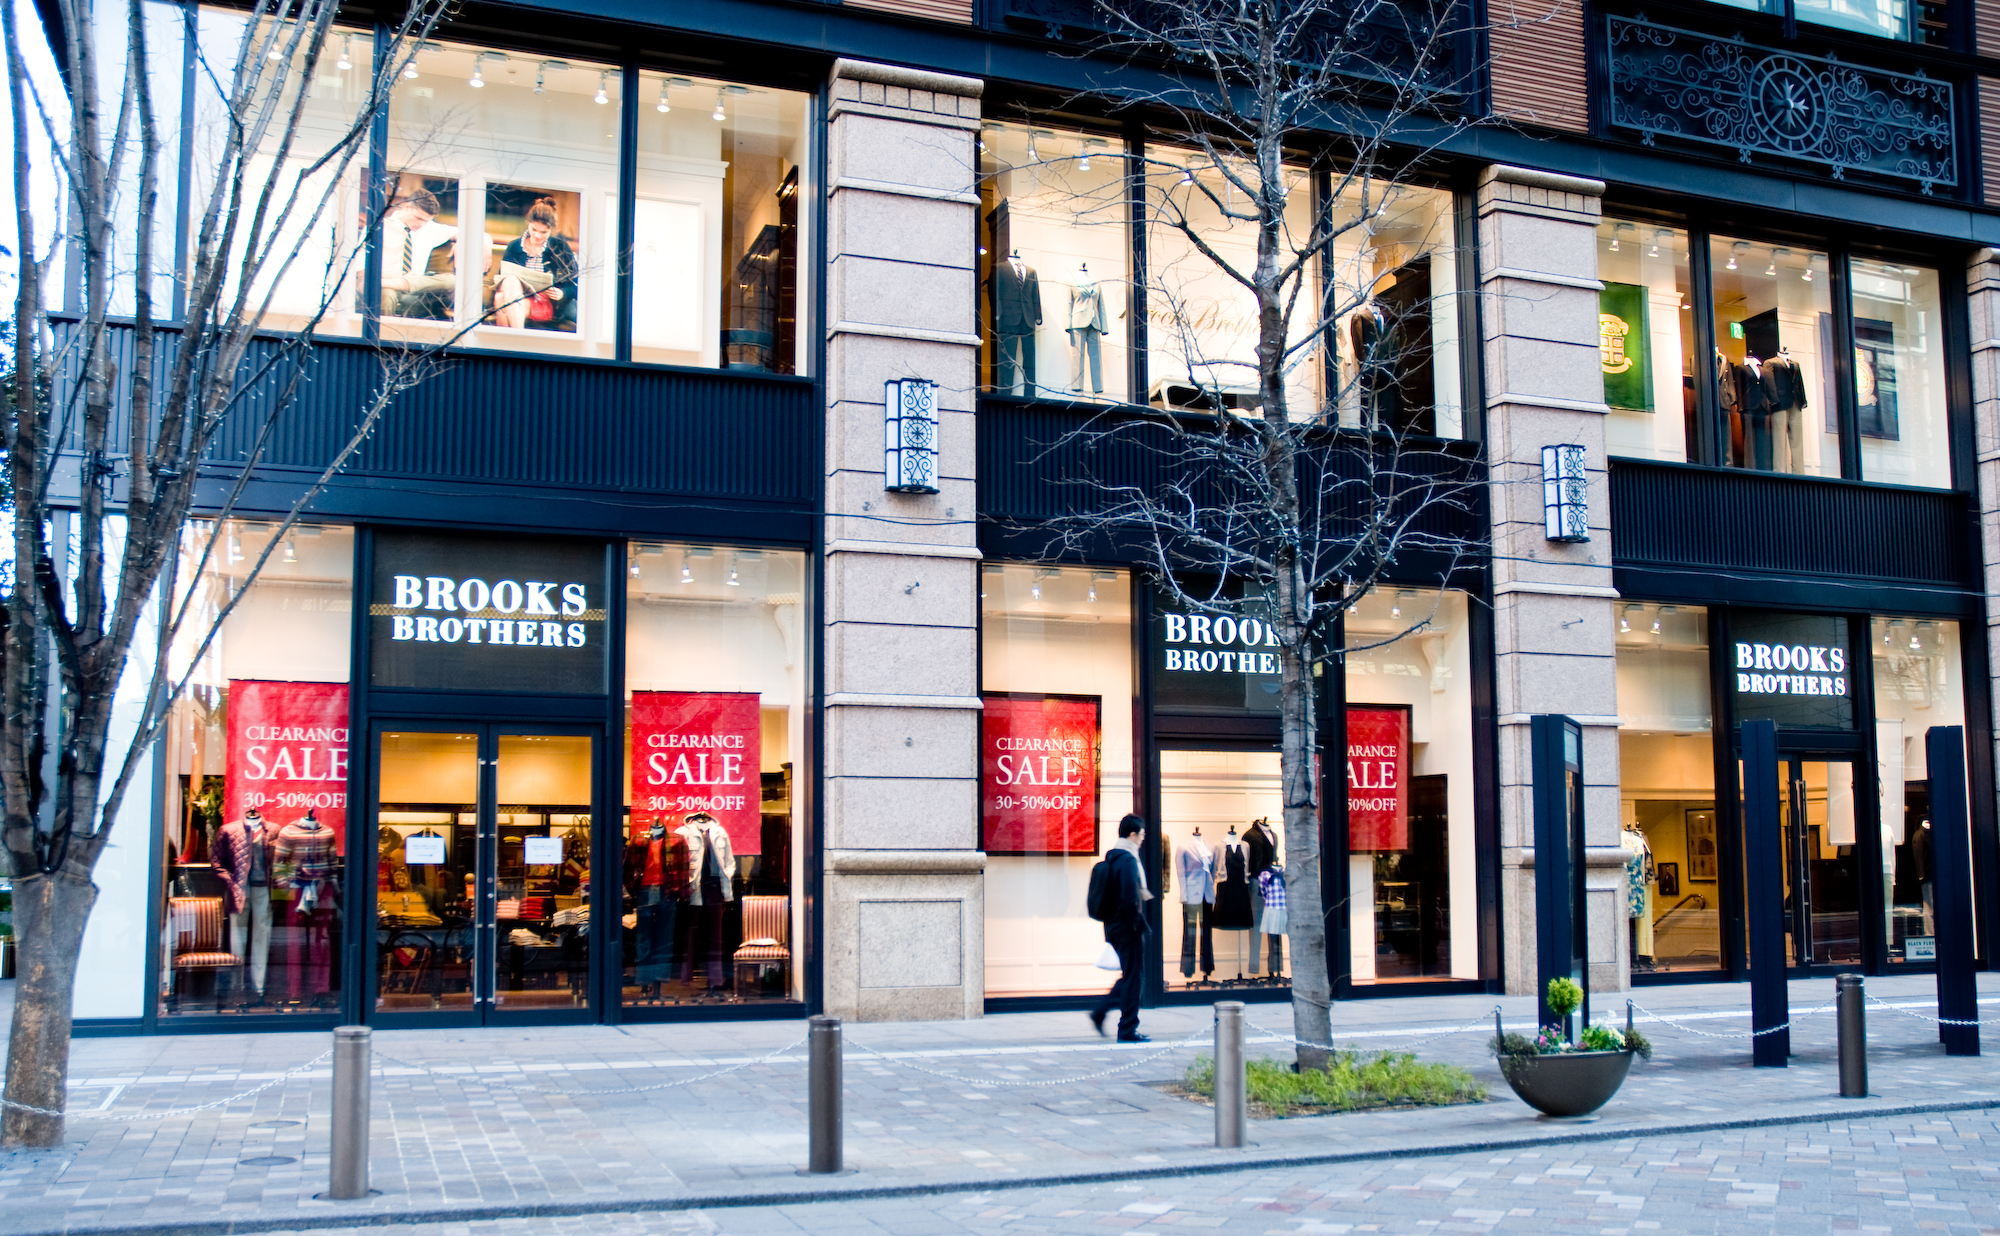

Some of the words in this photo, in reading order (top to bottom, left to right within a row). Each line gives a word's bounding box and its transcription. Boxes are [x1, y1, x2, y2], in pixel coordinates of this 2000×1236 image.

[393, 575, 587, 616] BROOKS
[392, 616, 586, 647] BROTHERS
[1165, 614, 1281, 647] BROOK
[1165, 649, 1282, 675] BROTHE
[1736, 643, 1845, 672] BROOKS
[1737, 673, 1846, 696] BROTHERS
[647, 733, 745, 749] CLEARANCE
[996, 737, 1082, 752] CLEARANCE
[1347, 744, 1397, 757] ARANCE
[244, 746, 348, 781] SALE
[647, 752, 745, 785] SALE
[995, 755, 1082, 786] SALE
[1346, 761, 1397, 789] ALE
[1347, 798, 1397, 811] 50%OFF
